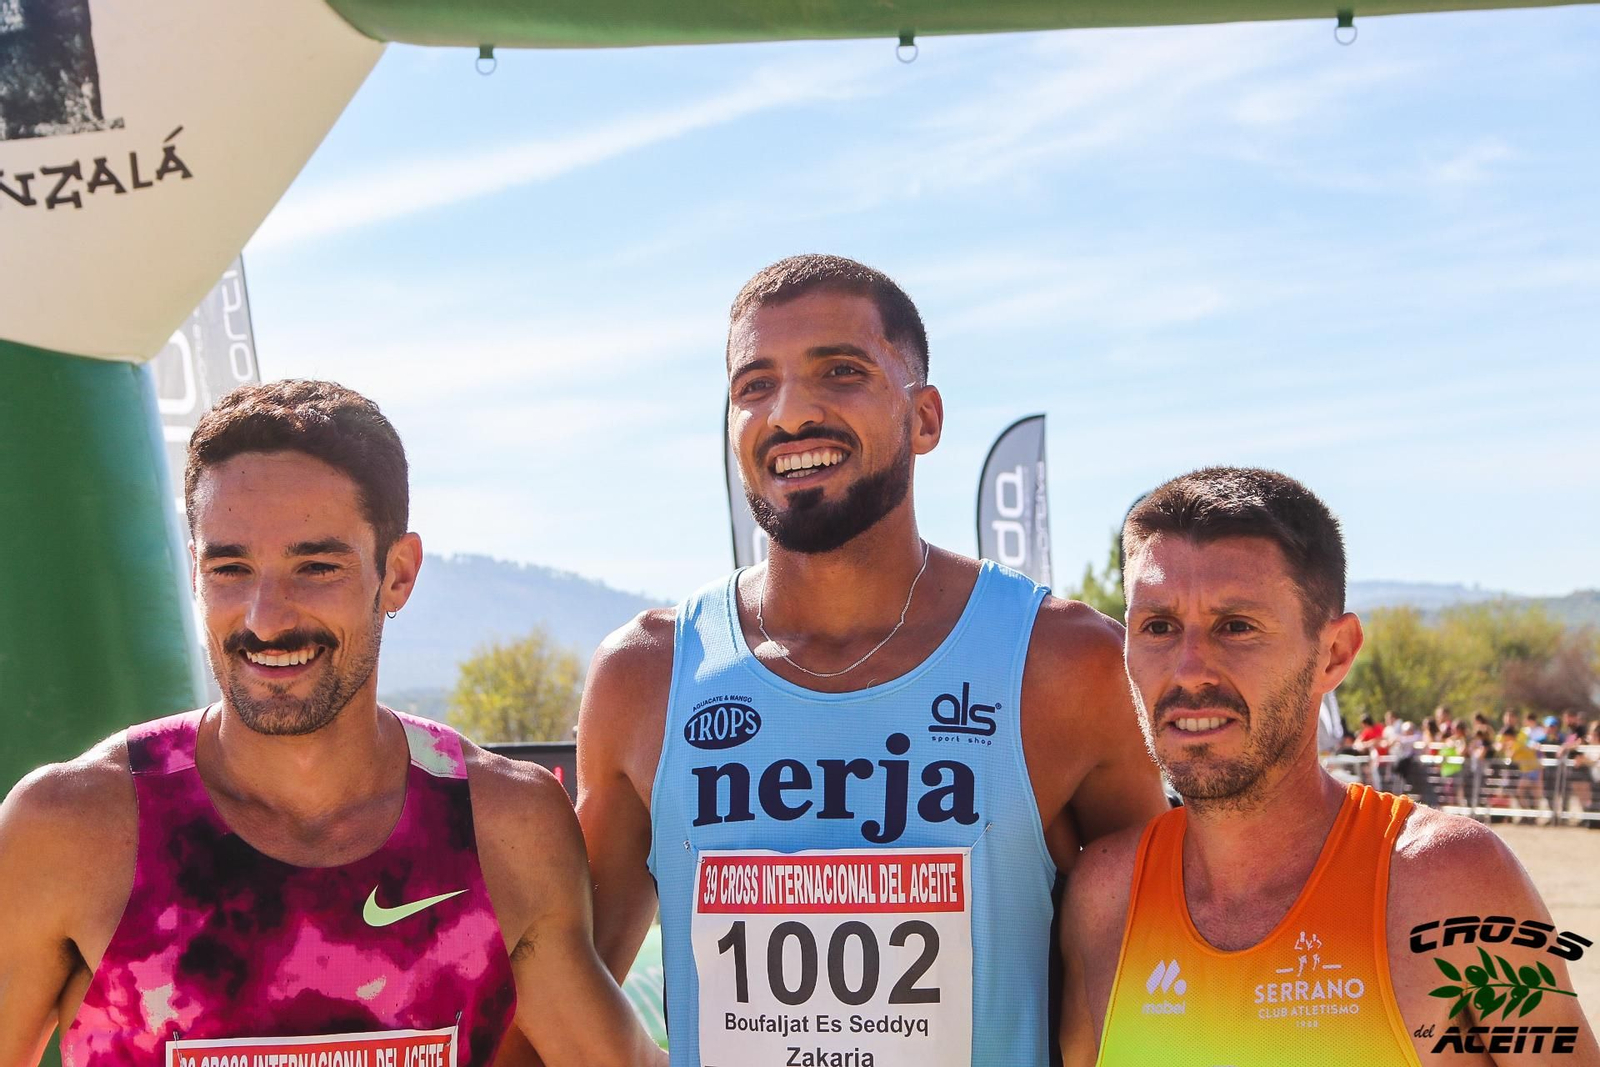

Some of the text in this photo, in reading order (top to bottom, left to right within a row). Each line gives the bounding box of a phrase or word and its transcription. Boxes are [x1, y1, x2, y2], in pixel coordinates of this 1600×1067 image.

[730, 695, 753, 703] MANGO
[688, 707, 758, 741] TROPS
[968, 737, 992, 746] shop
[691, 732, 980, 844] nerja
[703, 863, 958, 904] 39 CROSS INTERNACIONAL DEL ACEITE
[717, 920, 941, 1005] 1002
[1254, 978, 1365, 1003] SERRANO
[1258, 1004, 1360, 1019] CLUB ATLETISMO
[725, 1012, 929, 1037] Boufaljat Es Seddyq
[786, 1047, 875, 1067] Zakaria
